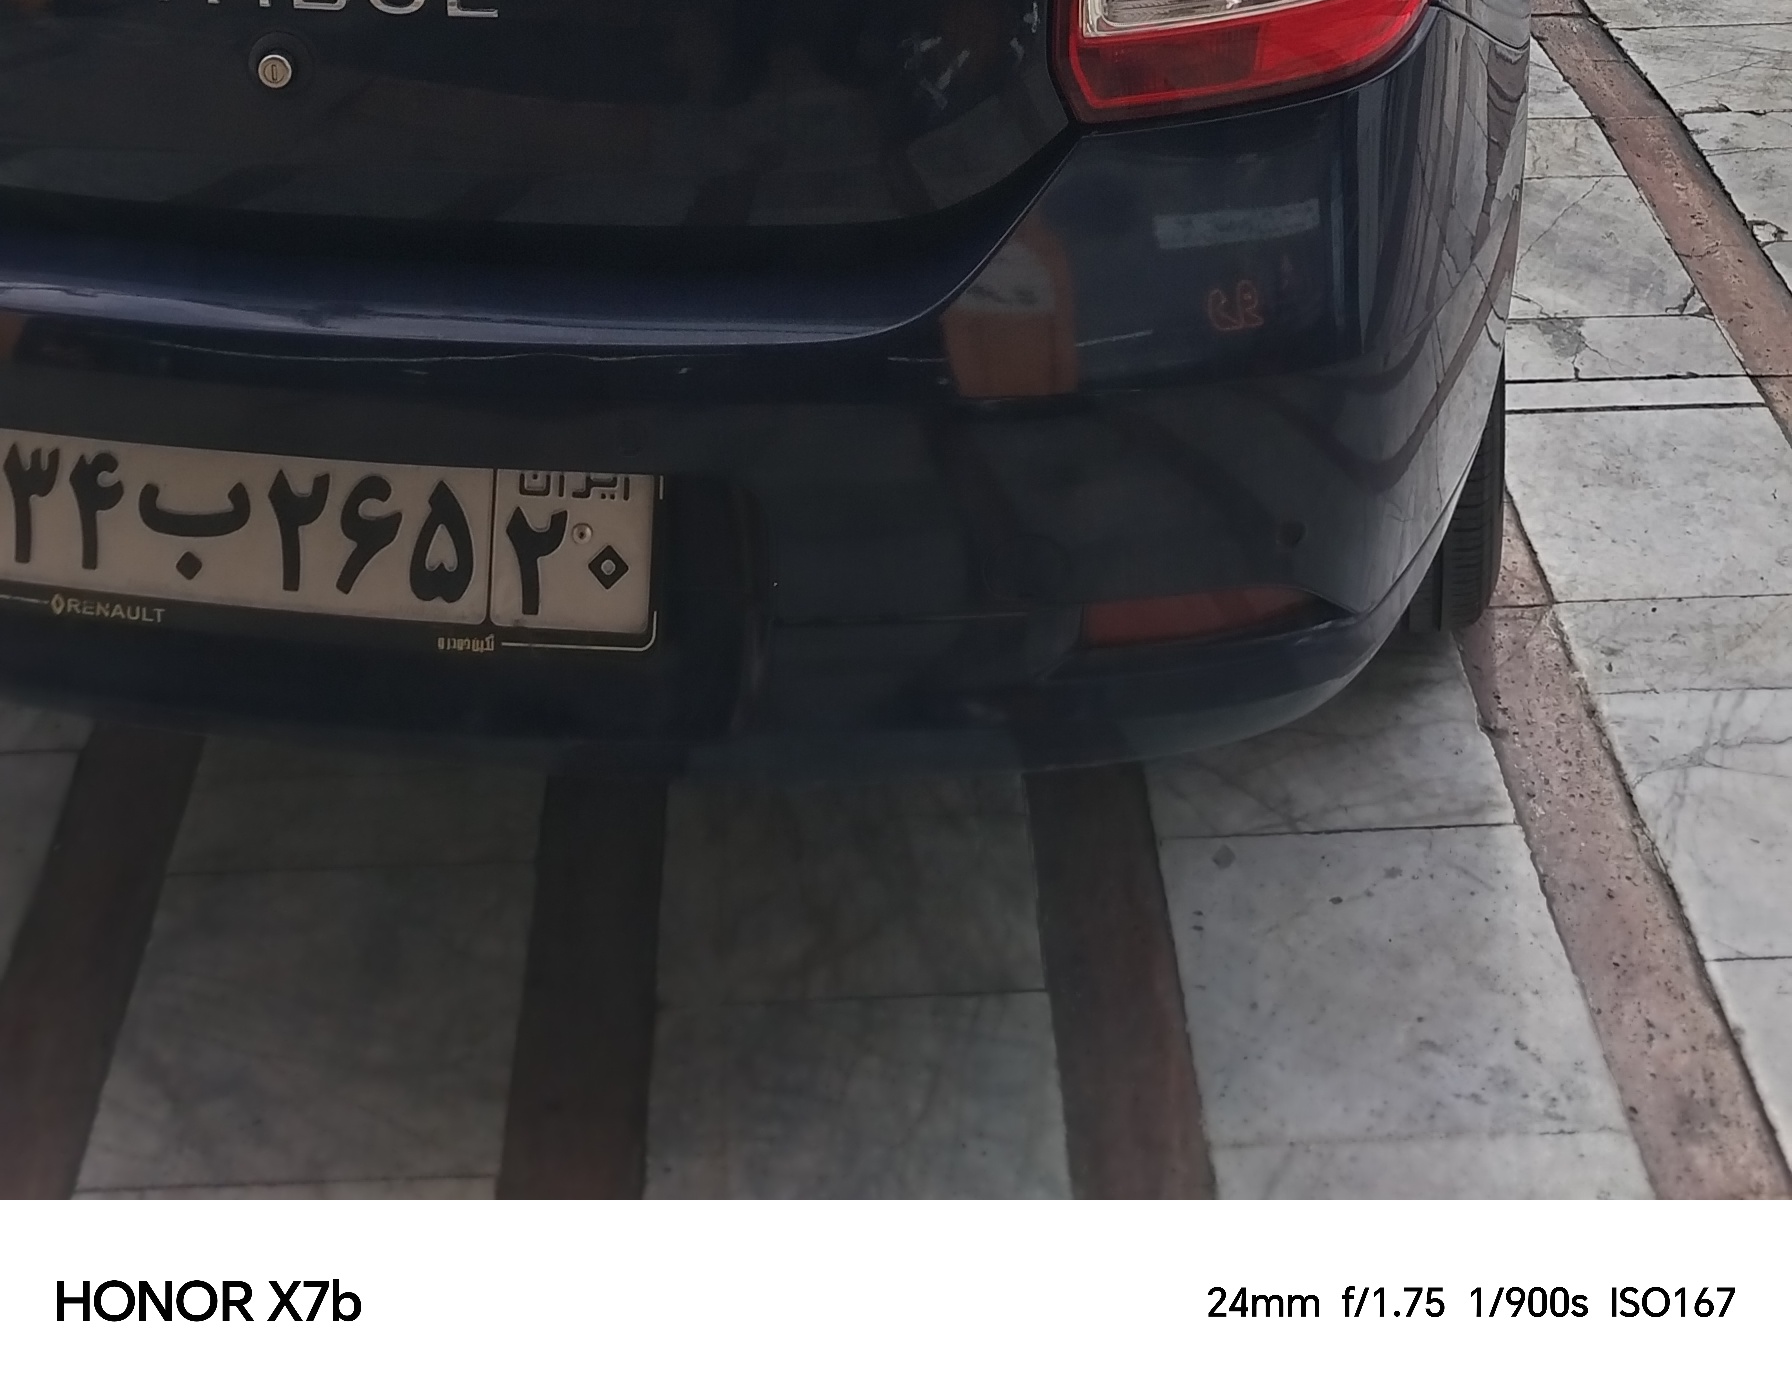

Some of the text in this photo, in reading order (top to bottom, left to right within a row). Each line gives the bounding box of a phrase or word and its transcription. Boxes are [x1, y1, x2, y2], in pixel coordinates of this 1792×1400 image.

[2, 441, 476, 605] ۳۴ ب ۲۶۵
[504, 504, 630, 616] ۲۰
[66, 596, 166, 623] RENAULT
